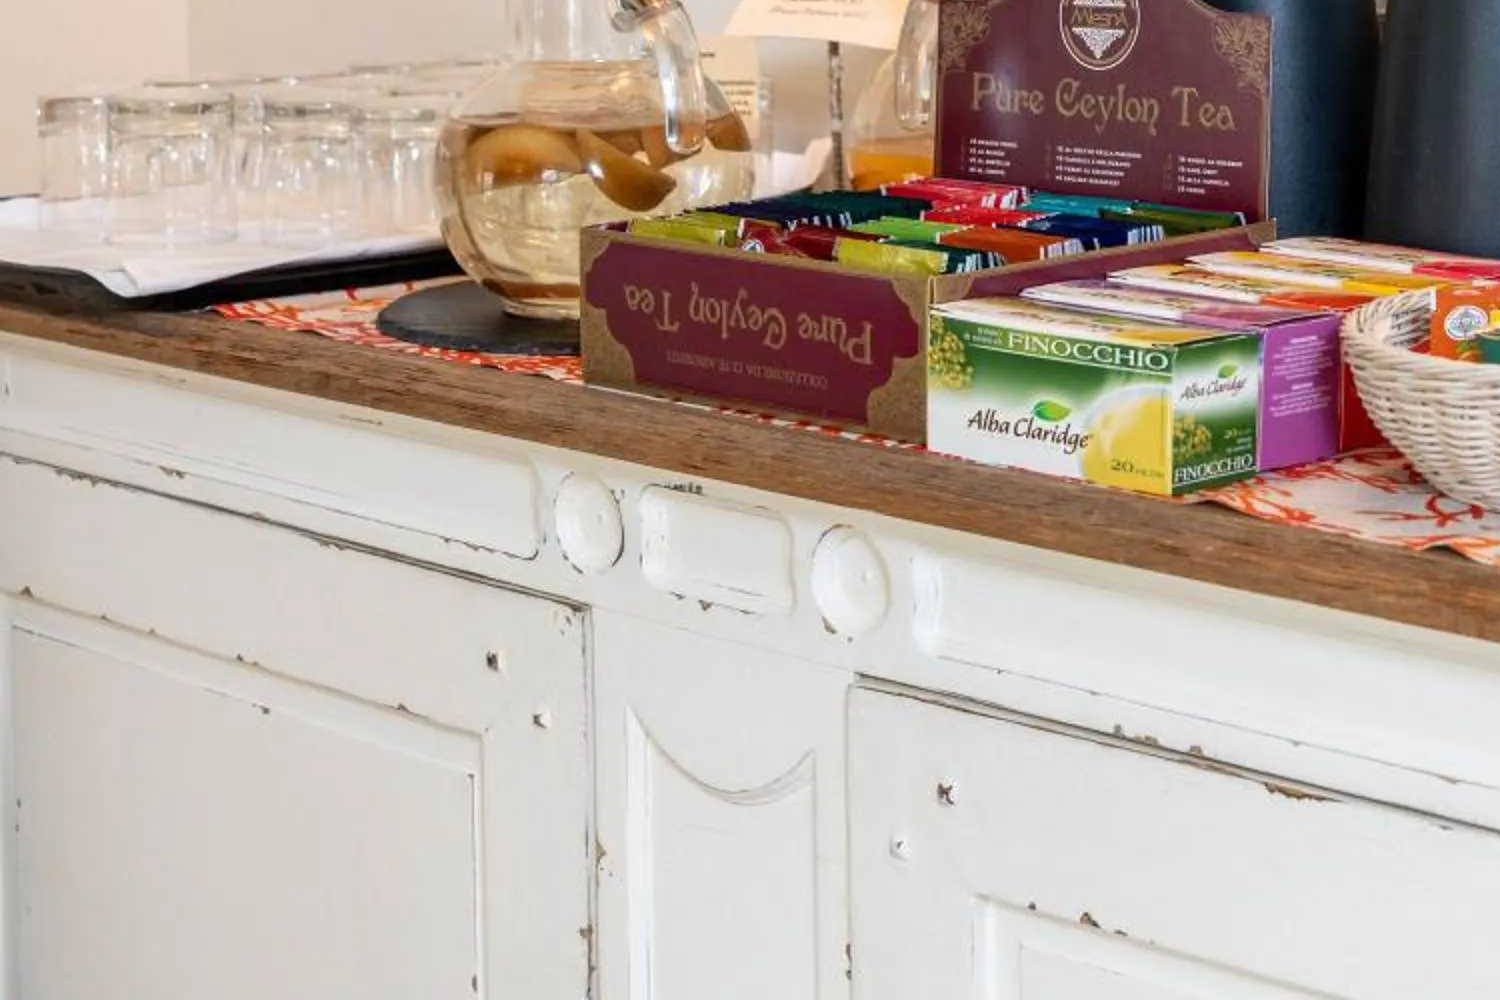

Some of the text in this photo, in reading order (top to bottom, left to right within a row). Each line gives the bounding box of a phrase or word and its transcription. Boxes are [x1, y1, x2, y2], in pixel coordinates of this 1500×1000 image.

[972, 72, 1237, 136] Pure Ceylon Tea
[623, 281, 874, 366] Pure Ceylon Tea
[1006, 332, 1170, 371] FINOCCHIO
[967, 408, 1090, 455] Alba Claridge
[1110, 458, 1135, 473] 20
[1174, 453, 1254, 483] FINOCCHIO
